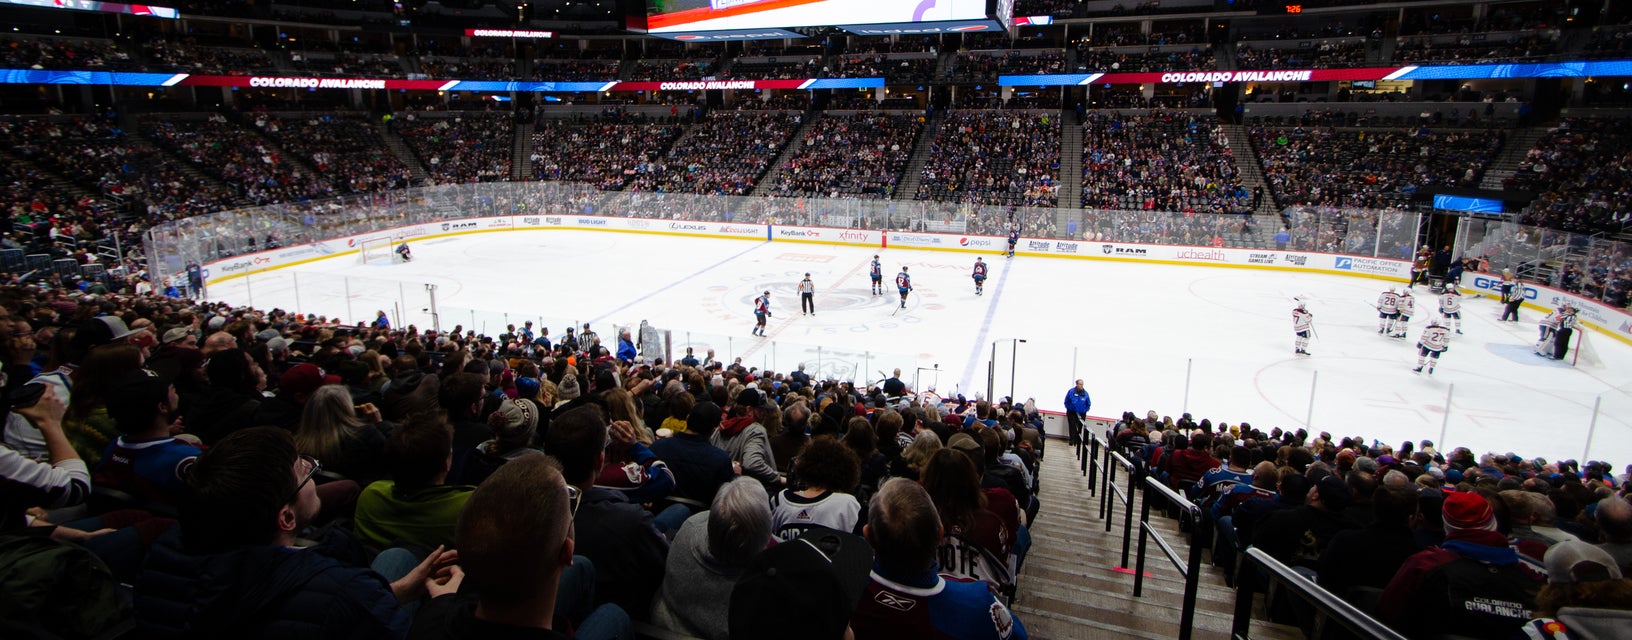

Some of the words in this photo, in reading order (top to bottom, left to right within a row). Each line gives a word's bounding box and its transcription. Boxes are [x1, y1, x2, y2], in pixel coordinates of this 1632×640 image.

[474, 29, 513, 37] COLORADO
[1161, 72, 1232, 82] COLORADO
[1232, 70, 1312, 82] AVALANCHE
[250, 77, 319, 88] COLORADO
[319, 79, 386, 89] AVALANCHE
[660, 82, 706, 90] COLORADO
[706, 81, 755, 90] AVALANCHE
[839, 231, 869, 242] xfinity
[970, 239, 991, 247] pepsi
[1177, 249, 1225, 261] uchealth
[221, 261, 253, 272] KeyBank
[1352, 263, 1398, 273] AUTOMATION
[1353, 257, 1379, 266] PACIFIC
[1379, 260, 1402, 268] OFFICE
[1474, 277, 1538, 300] GEO
[1384, 297, 1396, 306] 28
[1447, 297, 1453, 306] 6
[1431, 332, 1445, 342] 27
[1473, 596, 1523, 609] COLORADO
[1464, 600, 1533, 620] AVALANCHE
